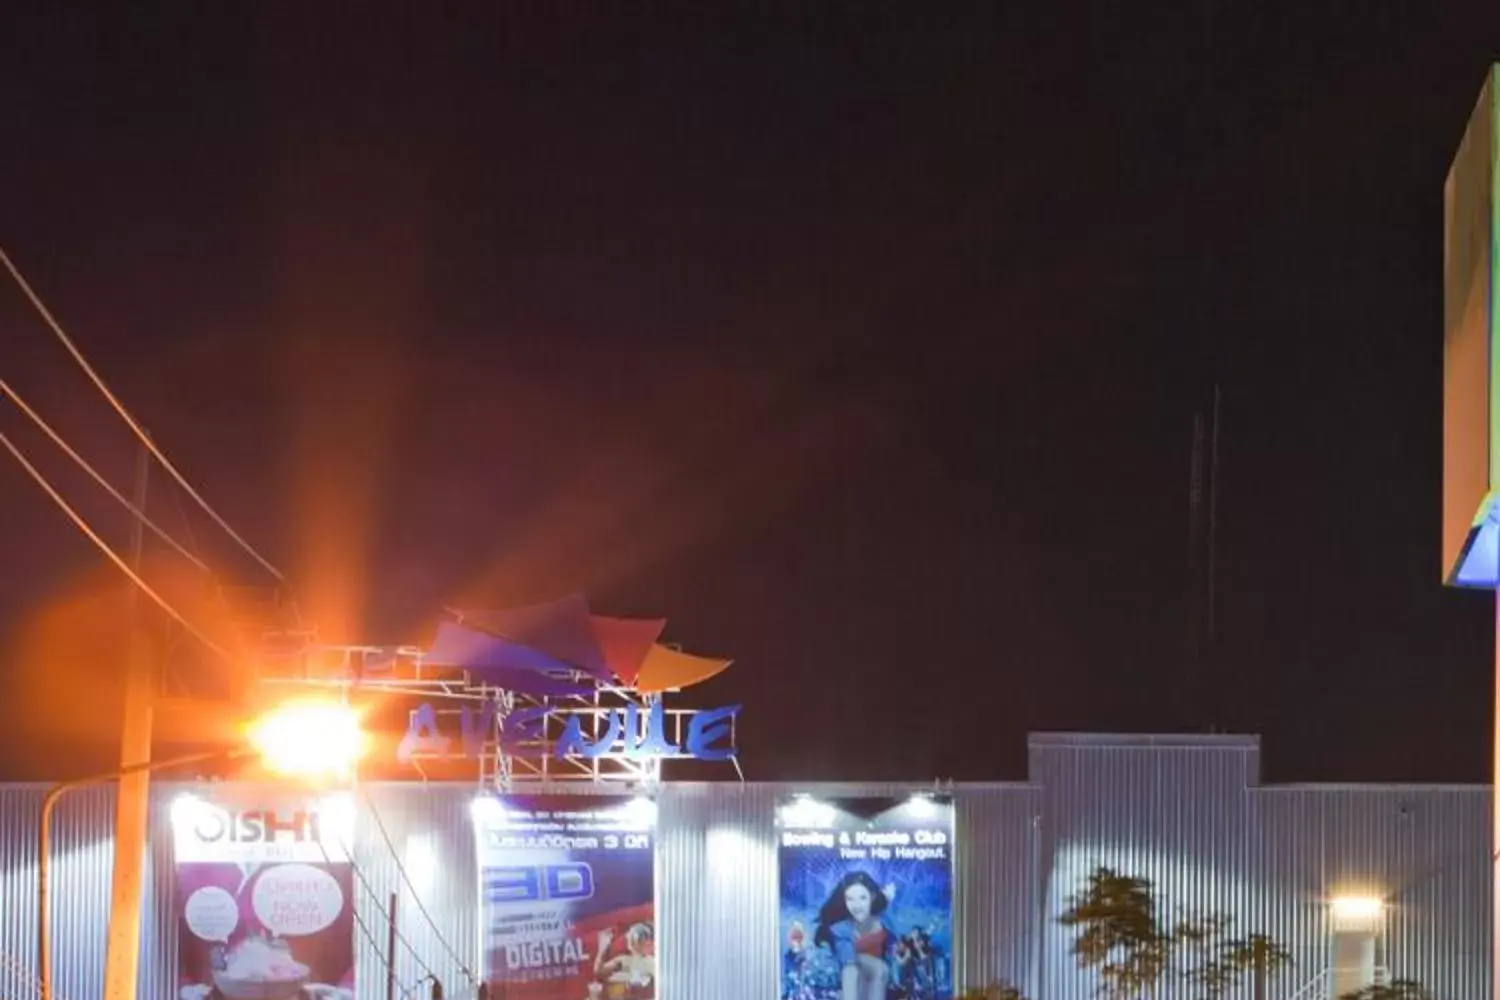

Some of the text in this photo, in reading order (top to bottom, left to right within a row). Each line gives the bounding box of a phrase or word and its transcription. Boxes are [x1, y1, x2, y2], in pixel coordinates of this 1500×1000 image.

[603, 834, 619, 850] 3
[914, 829, 947, 845] Club
[482, 861, 596, 902] 3D
[504, 936, 591, 969] DIGITAL
